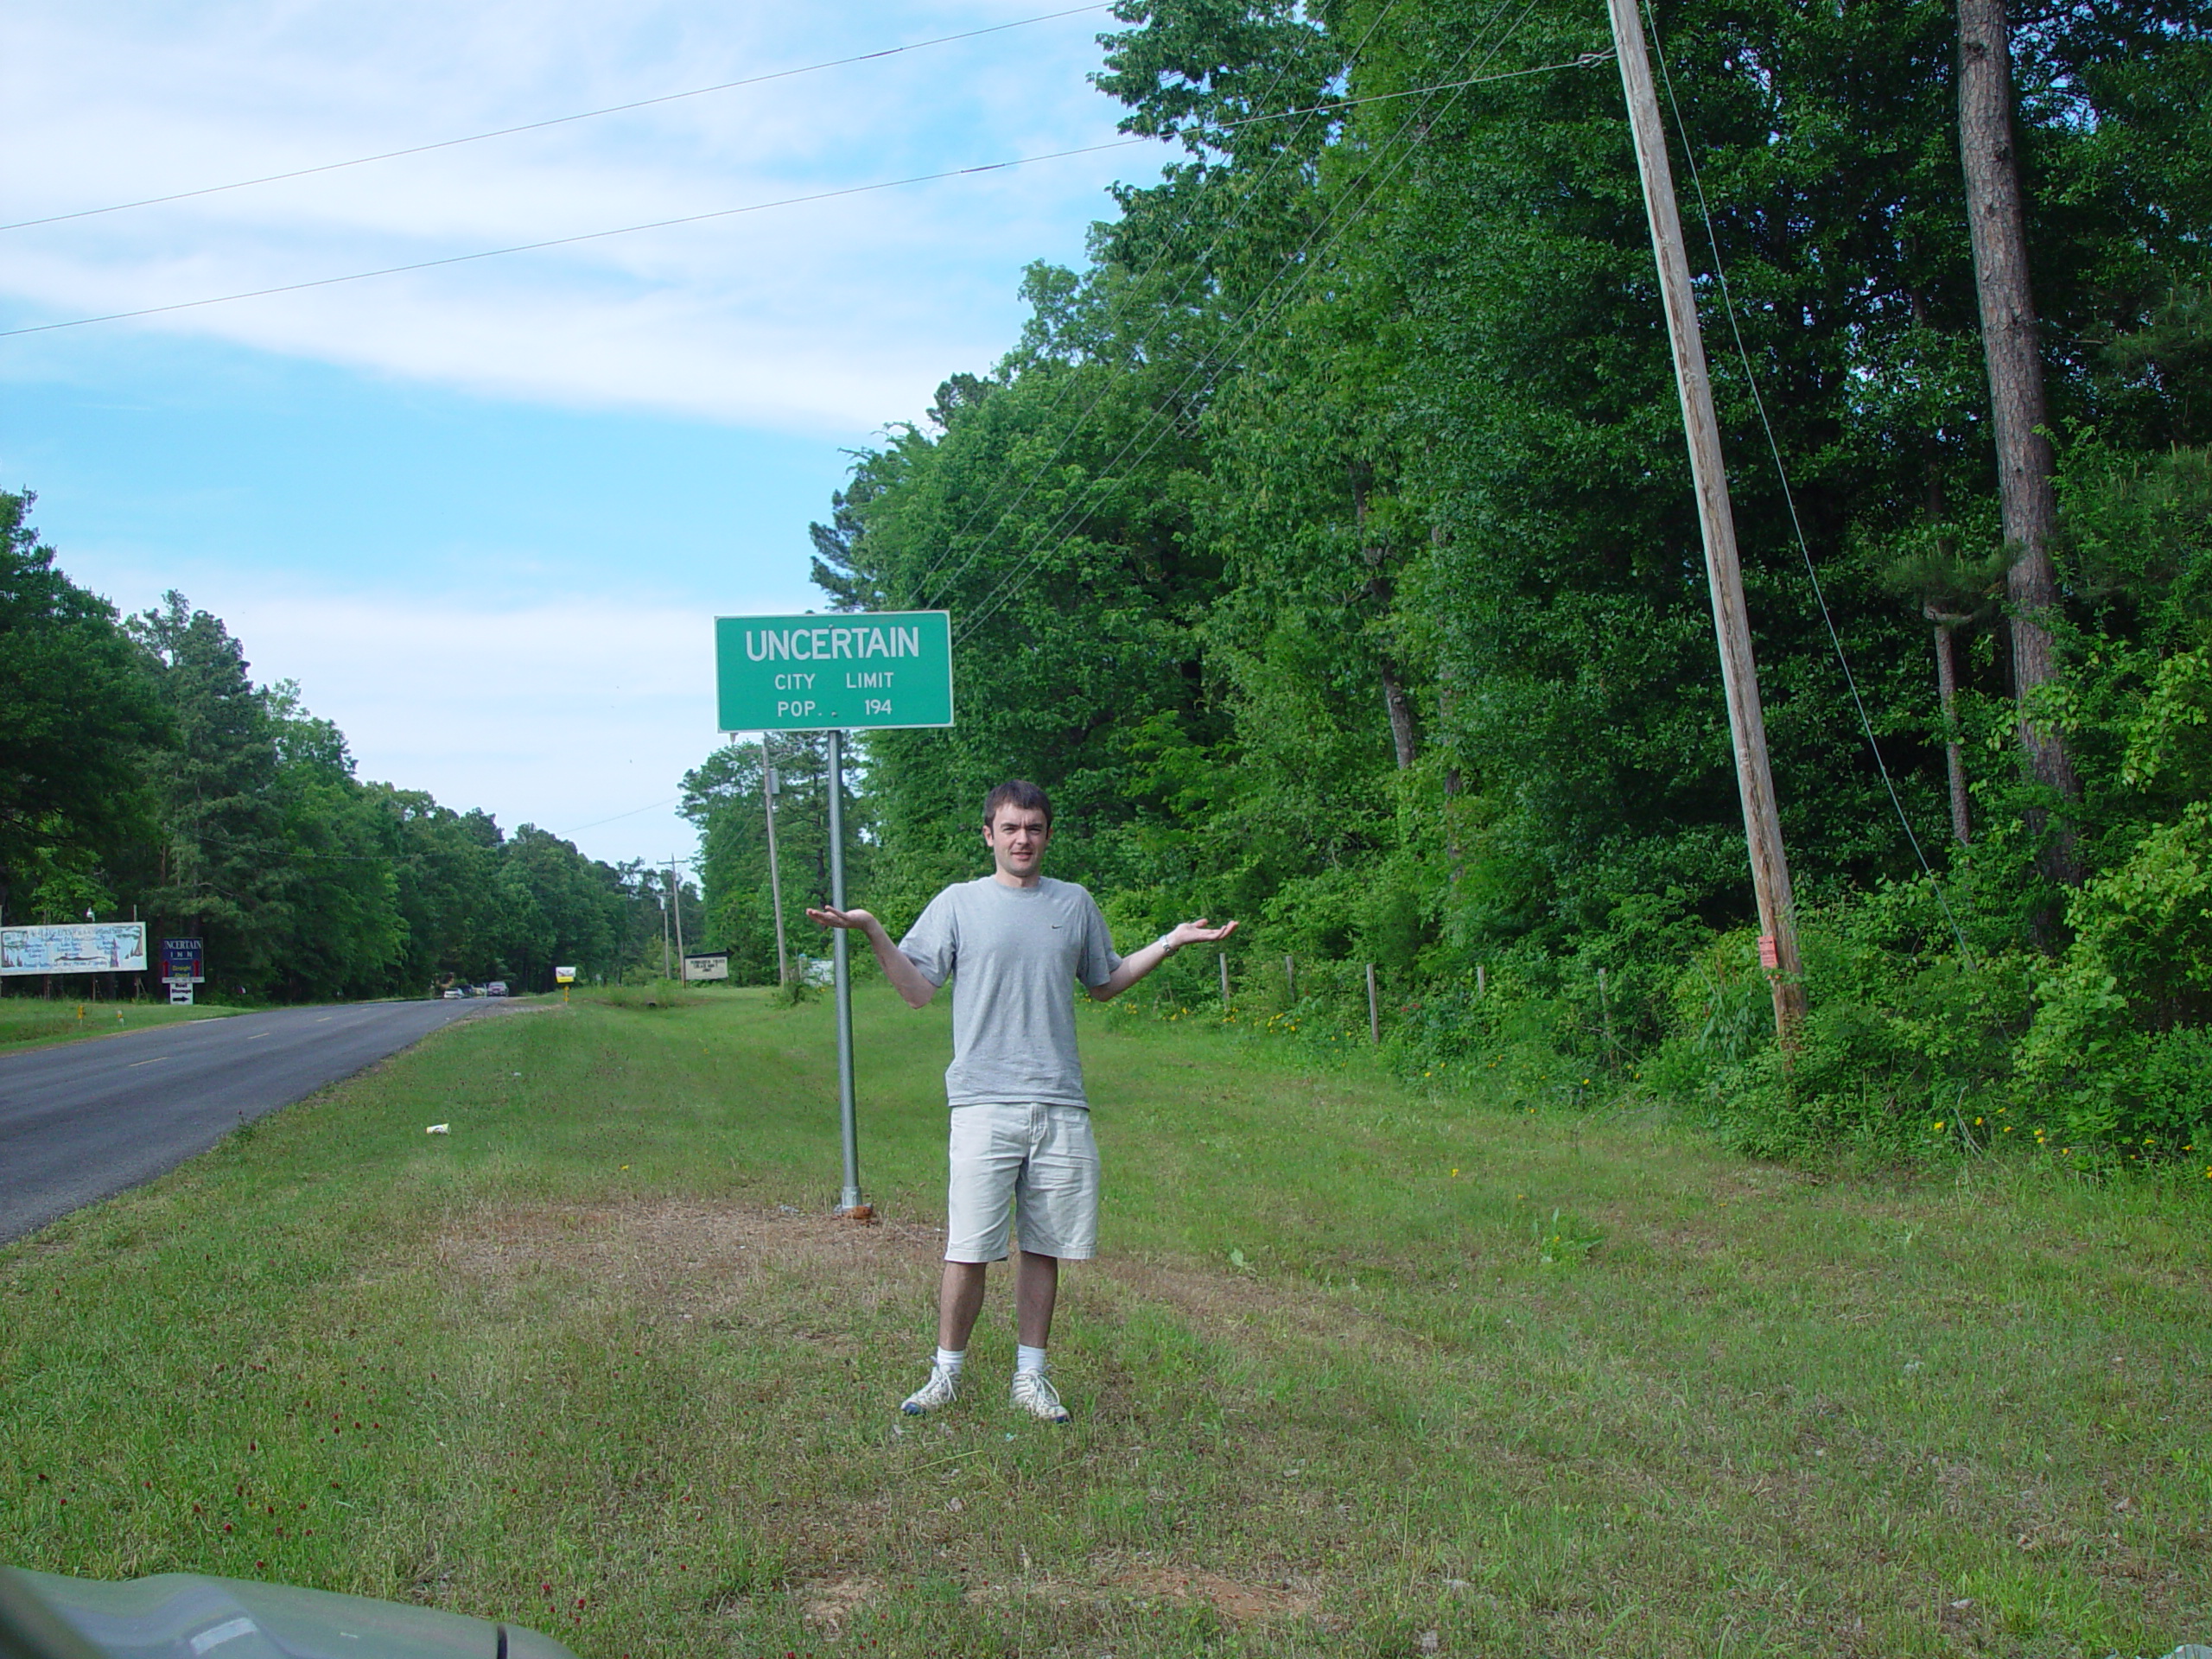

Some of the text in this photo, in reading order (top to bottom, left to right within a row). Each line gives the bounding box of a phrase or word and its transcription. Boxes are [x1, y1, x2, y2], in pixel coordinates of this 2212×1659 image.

[746, 626, 919, 662] UNCERTAIN
[774, 671, 894, 690] CITY LIMIT
[777, 699, 893, 717] POP. 194
[162, 940, 202, 949] NCERTAIN
